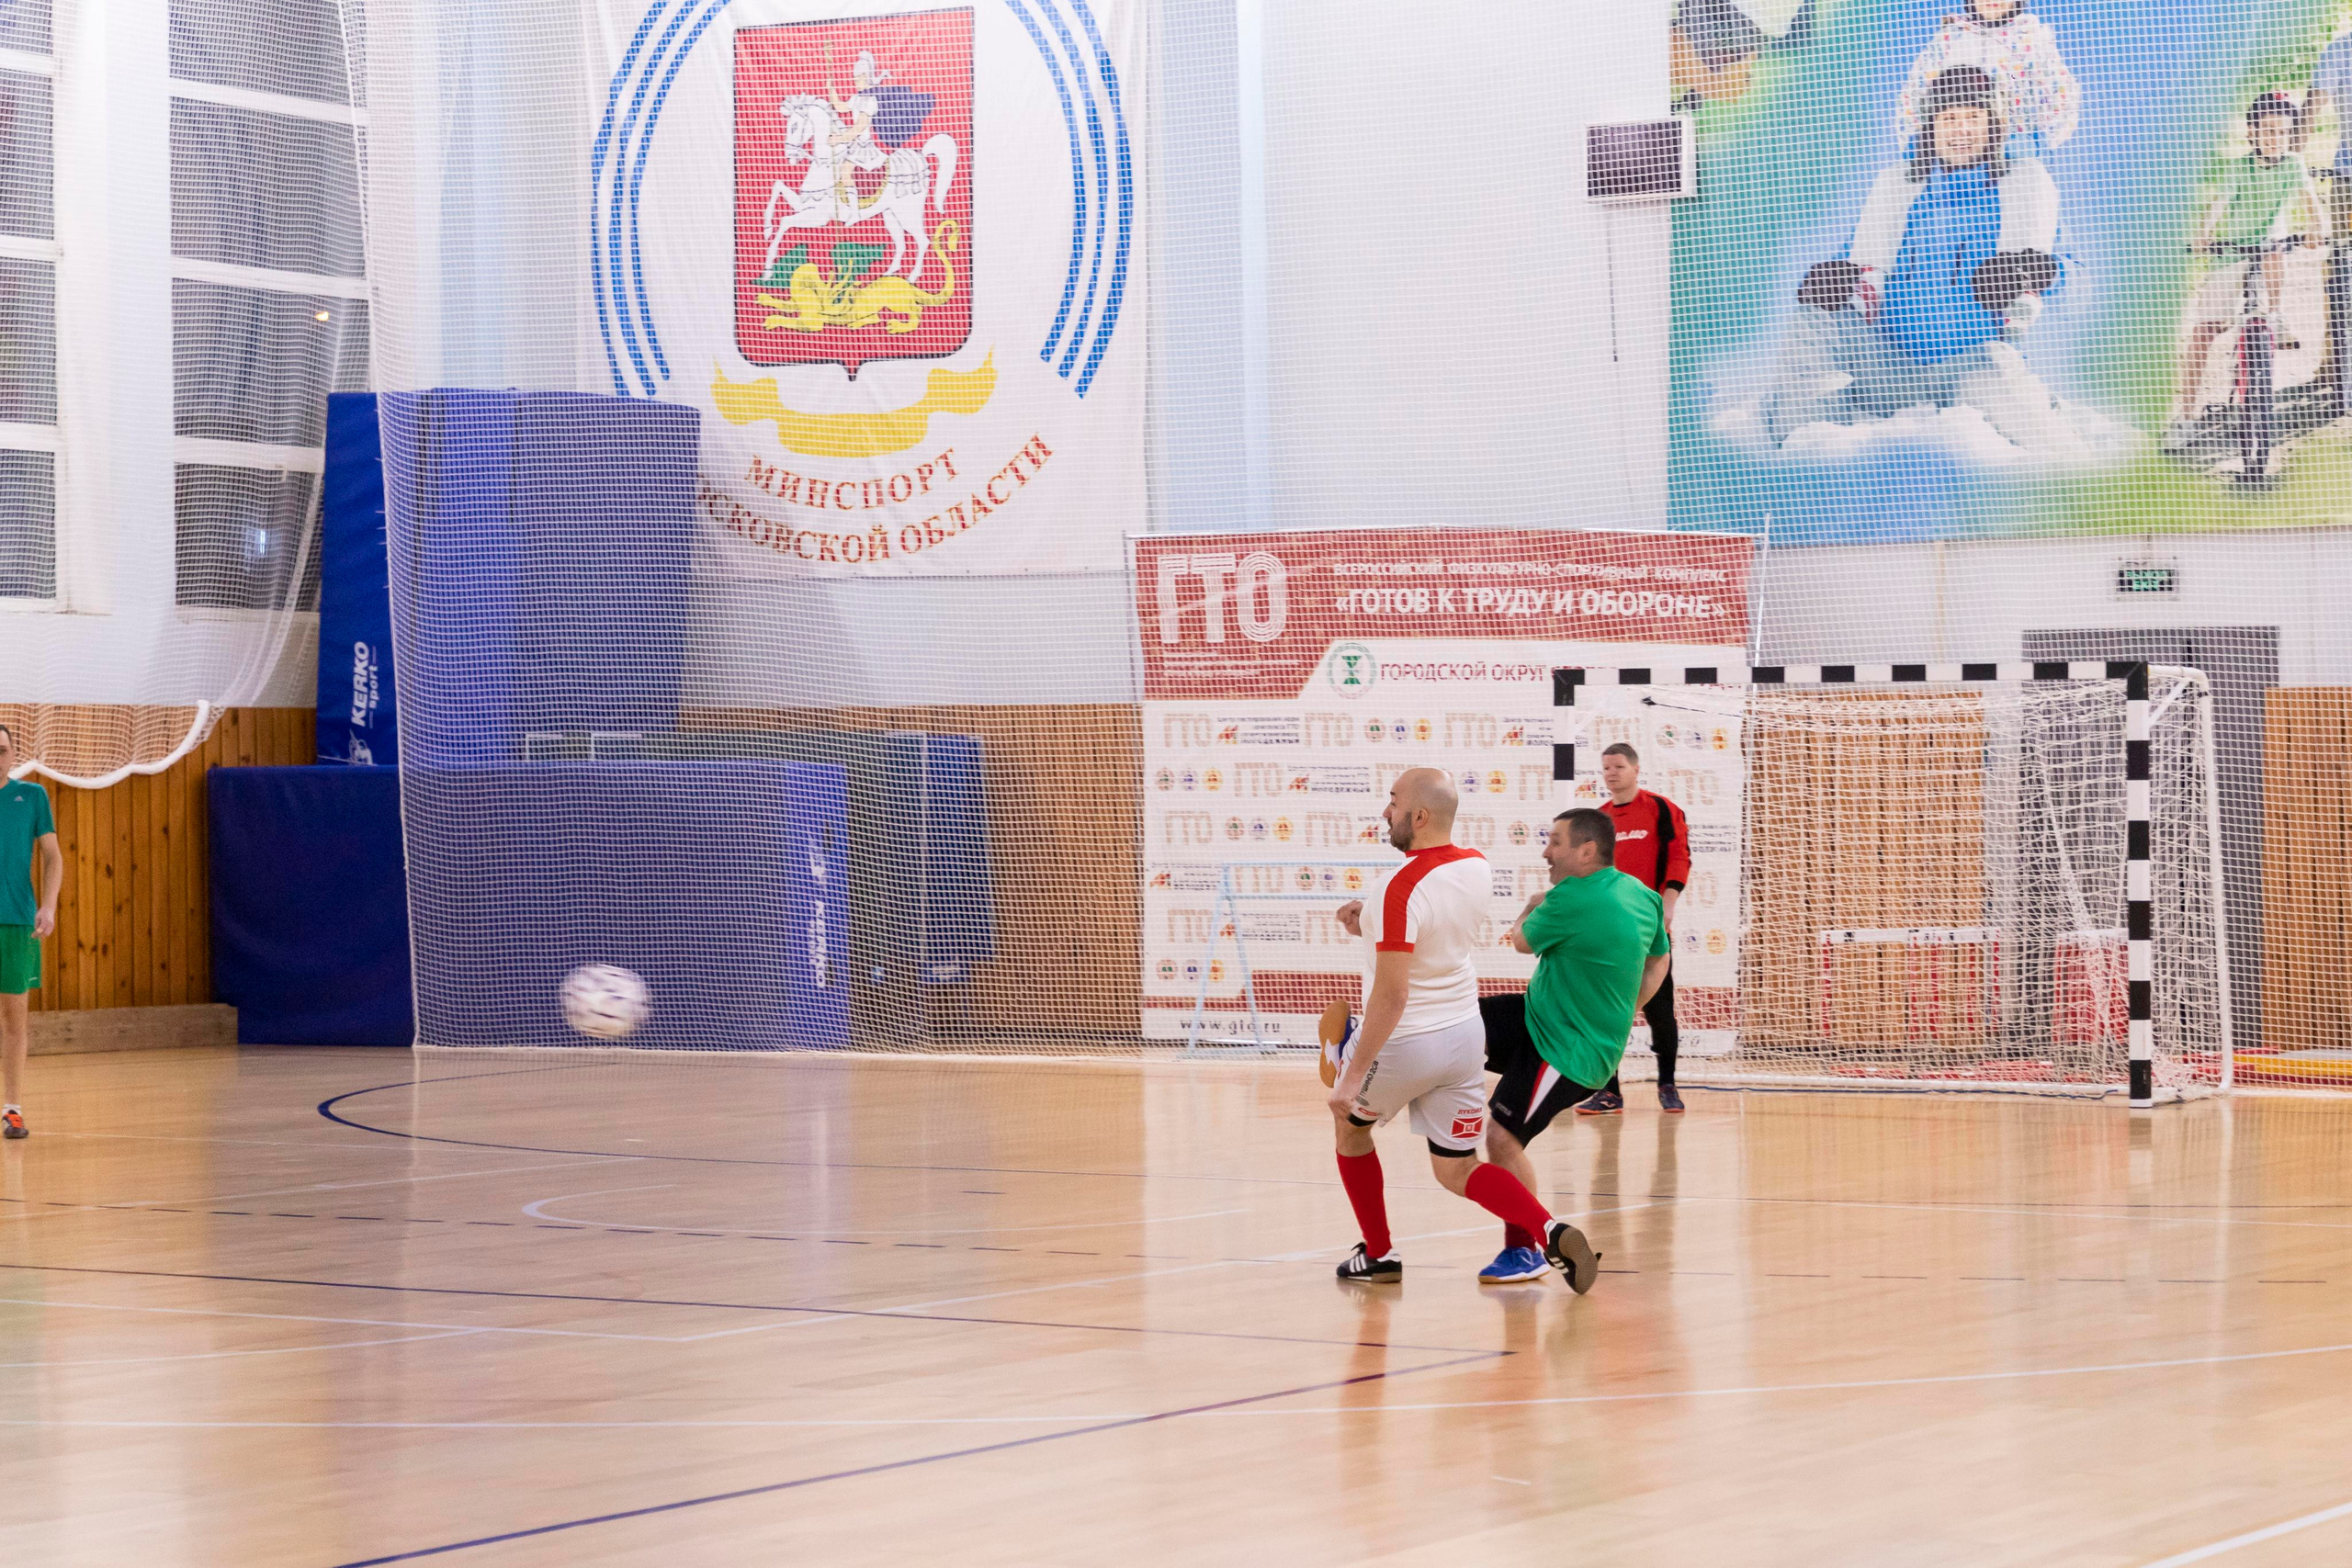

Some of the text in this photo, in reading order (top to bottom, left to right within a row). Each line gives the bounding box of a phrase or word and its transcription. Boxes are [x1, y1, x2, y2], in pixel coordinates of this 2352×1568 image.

[698, 433, 1055, 563] СКОВСКОЙ ОБЛАСТИ
[744, 447, 960, 511] МИНСПОРТ
[1158, 553, 1287, 643] ГТО
[1336, 589, 1725, 618] «ГОТОВ К ТРУДУ И ОБОРОНЕ»
[351, 641, 369, 728] KERKO
[368, 664, 380, 709] sport
[1381, 660, 1486, 682] ГОРОДСКОЙ
[1491, 663, 1546, 682] ОКРУГ
